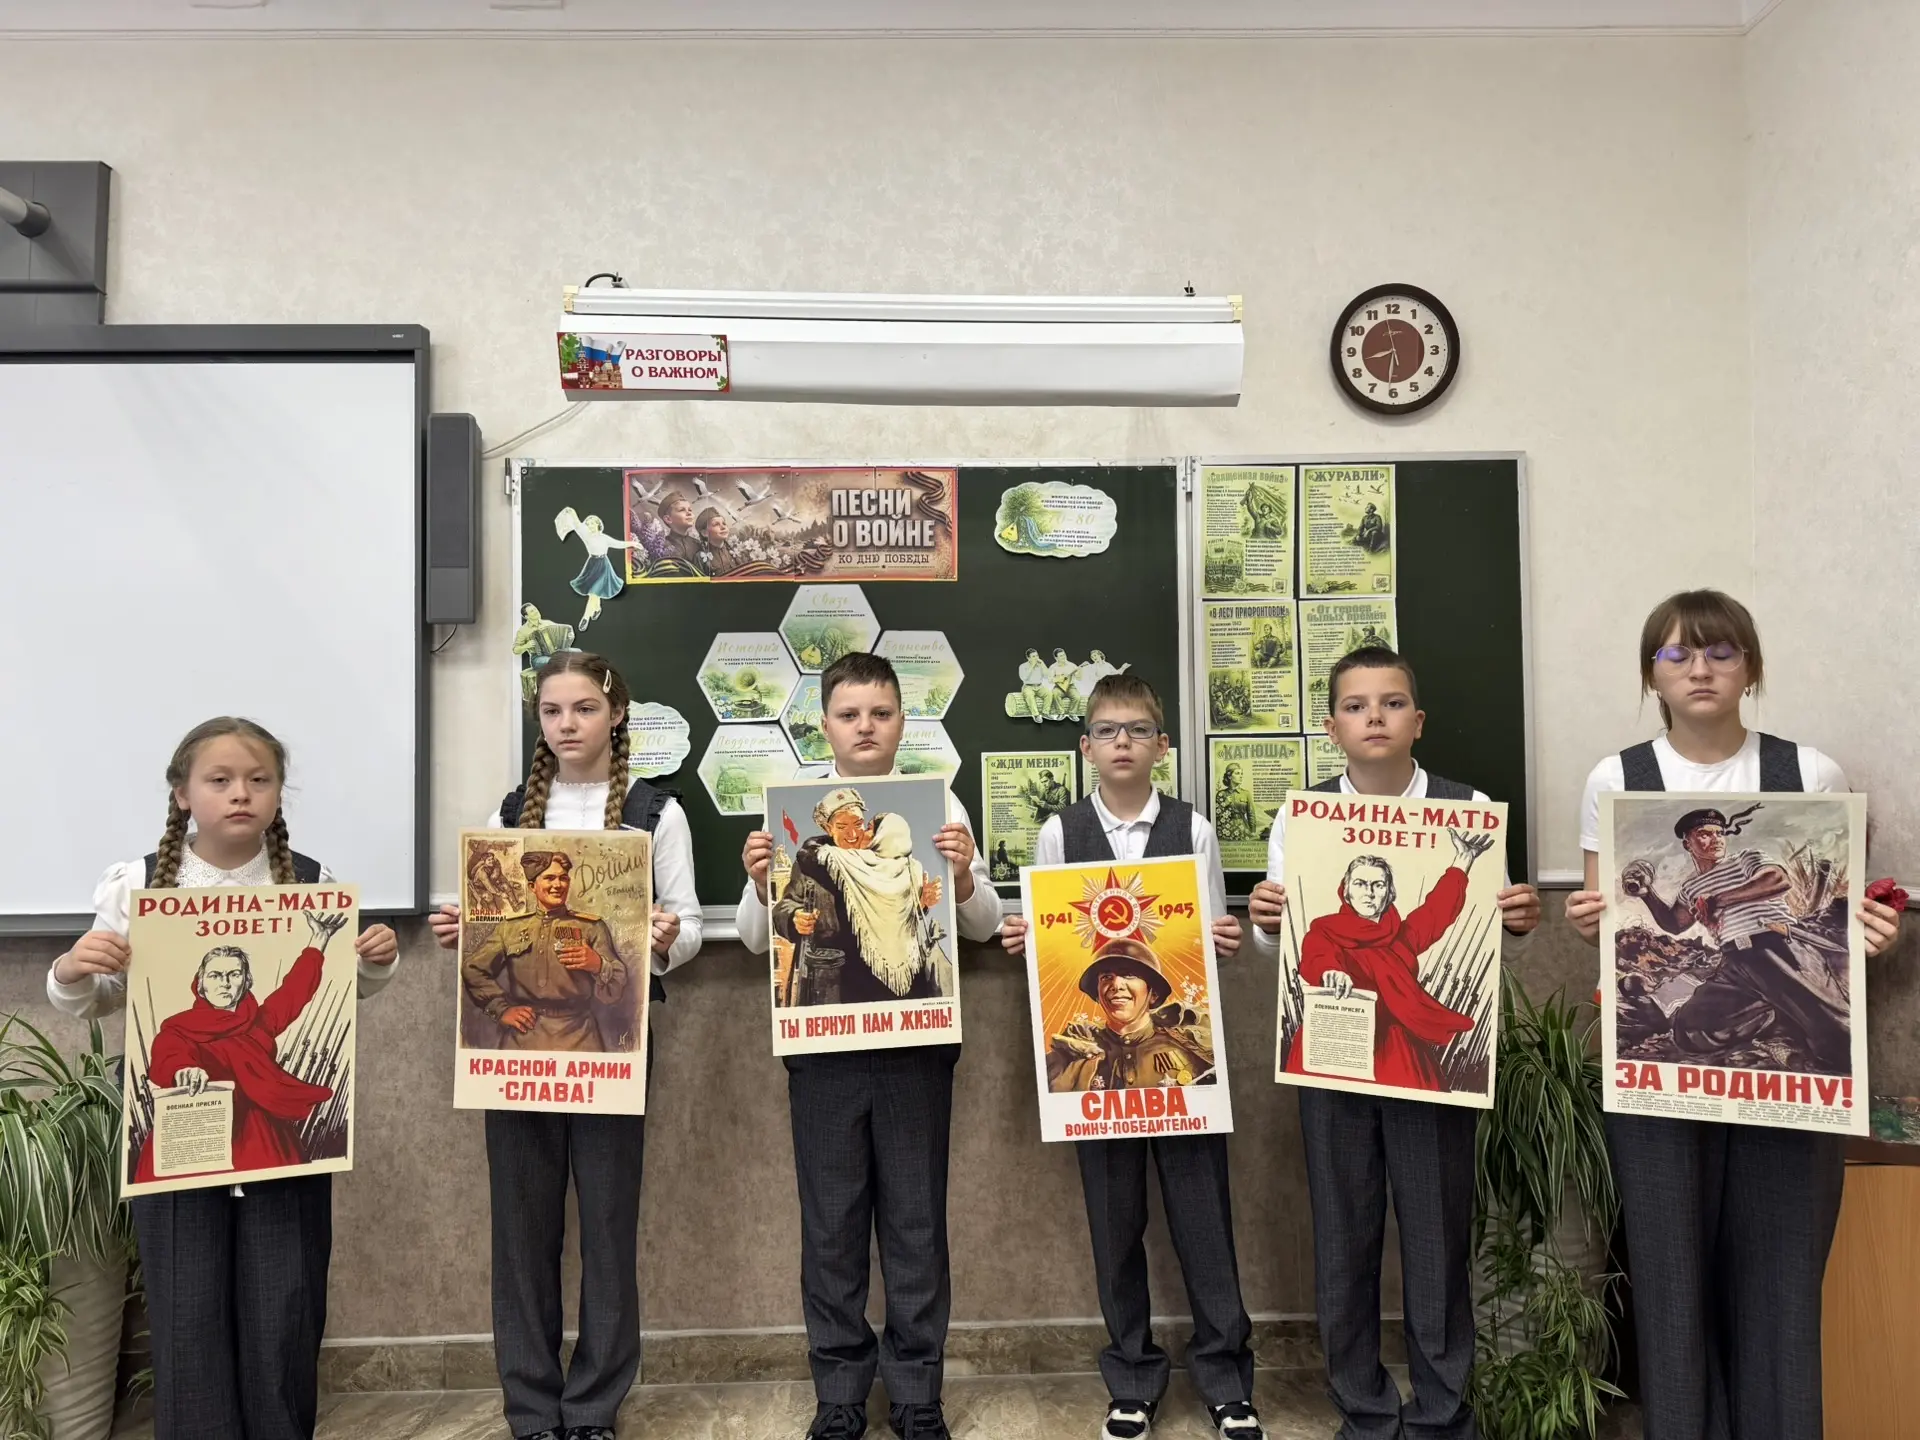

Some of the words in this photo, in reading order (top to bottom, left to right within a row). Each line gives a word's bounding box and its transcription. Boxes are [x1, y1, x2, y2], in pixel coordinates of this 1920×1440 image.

[1366, 310, 1378, 320] 11
[1385, 304, 1400, 314] 12
[1410, 309, 1417, 319] 1
[1349, 326, 1365, 336] 10
[1424, 324, 1433, 334] 2
[625, 348, 722, 362] РАЗГОВОРЫ
[1347, 347, 1356, 357] 9
[1430, 345, 1439, 355] 3
[631, 366, 644, 378] О
[648, 366, 718, 379] ВАЖНОМ
[1352, 368, 1362, 378] 8
[1424, 366, 1434, 376] 4
[1368, 383, 1377, 393] 7
[1388, 388, 1398, 398] 6
[1409, 382, 1419, 392] 5
[1308, 470, 1385, 482] «ЖУРАВЛИ»
[831, 489, 912, 516] ПЕСНИ
[833, 520, 849, 547] О
[855, 513, 935, 547] ВОЙНЕ
[838, 555, 853, 564] КО
[857, 554, 880, 564] ДНЮ
[884, 554, 929, 564] ПОБЕДЫ
[1218, 607, 1234, 618] ЛЕСУ
[1218, 743, 1295, 760] «КАТЮША»
[991, 758, 1022, 770] «ЖДИ
[1026, 757, 1064, 769] МЕНЯ»
[1292, 799, 1500, 830] РОДИНА-МАТЬ
[1342, 827, 1437, 849] ЗОВЕТ!
[138, 891, 353, 917] РОДИНА-МАТЬ
[1158, 902, 1195, 920] 1945
[1040, 912, 1072, 929] 1941
[196, 917, 293, 937] ЗОВЕТ!
[779, 1019, 800, 1039] ТЫ
[806, 1015, 856, 1038] ВЕРНУЛ
[863, 1012, 893, 1033] НАМ
[900, 1006, 953, 1031] ЖИЗНЬ!
[469, 1057, 557, 1077] КРАСНОЙ
[565, 1060, 632, 1080] АРМИИ
[1615, 1062, 1663, 1091] ЗА
[1677, 1066, 1853, 1109] РОДИНУ!
[166, 1102, 194, 1111] ВОЕННАЯ
[196, 1100, 222, 1108] ПРИСЯГА
[1081, 1087, 1188, 1121] СЛАВА
